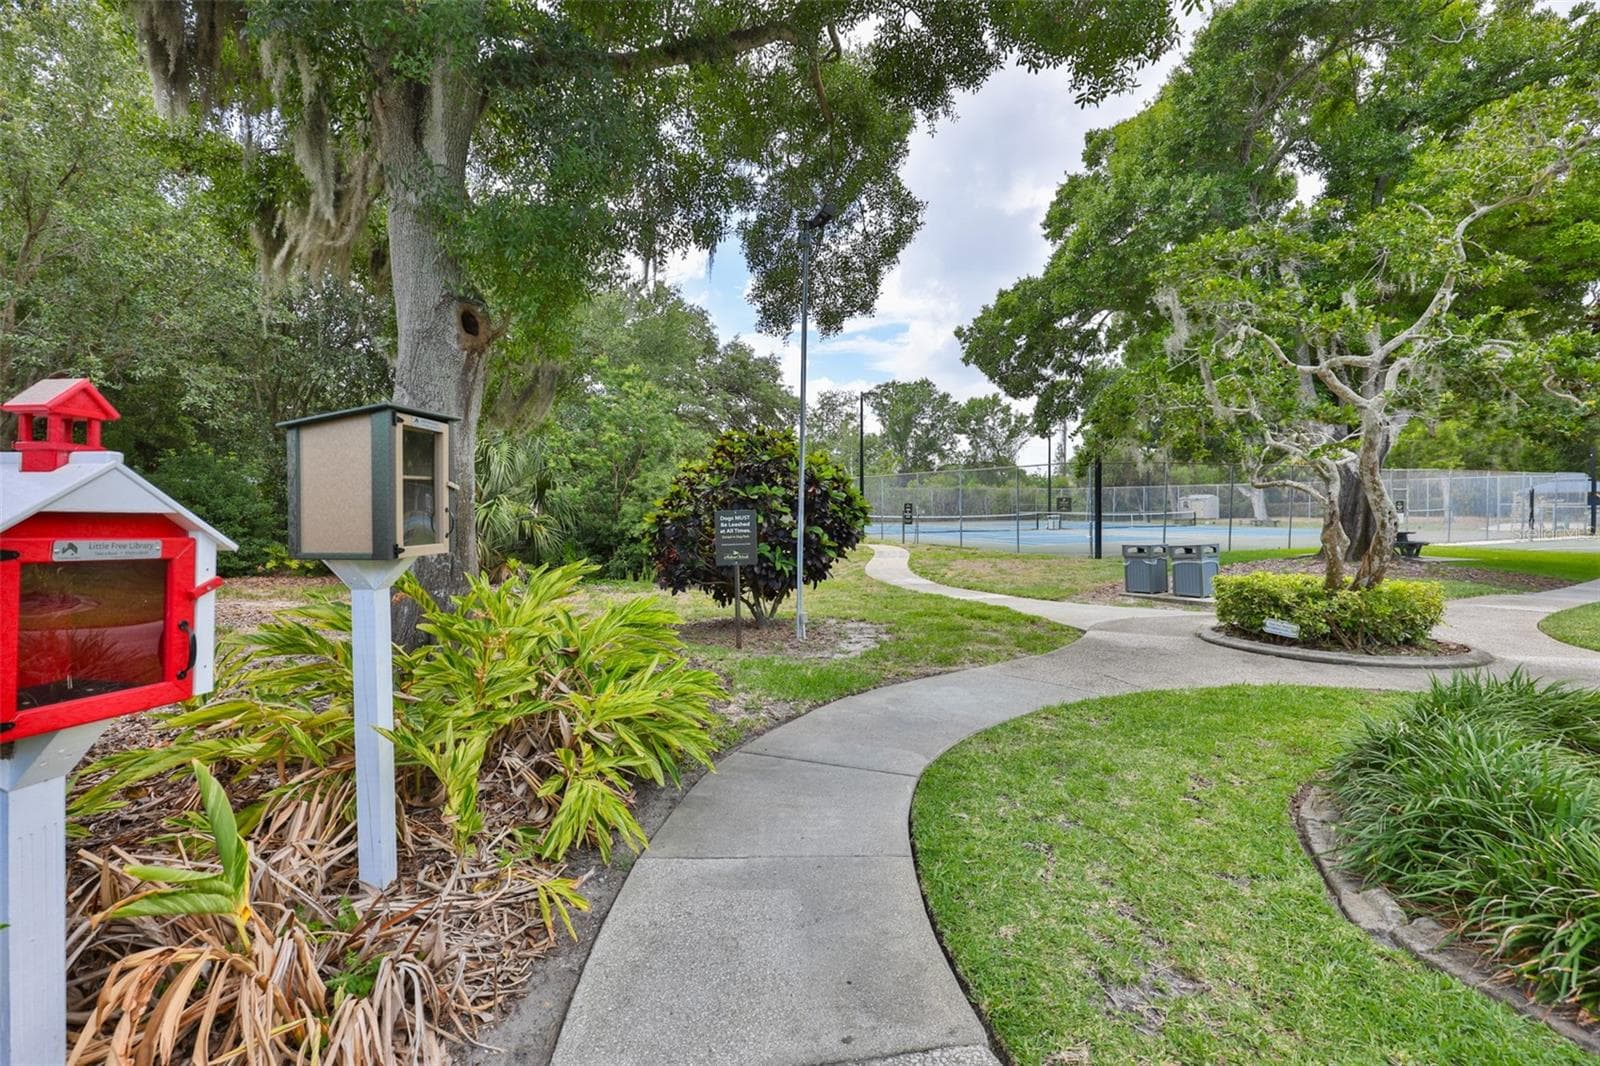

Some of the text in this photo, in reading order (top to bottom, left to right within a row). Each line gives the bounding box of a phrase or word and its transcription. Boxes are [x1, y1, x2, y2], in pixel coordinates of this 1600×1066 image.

[88, 541, 153, 551] Little Free Library
